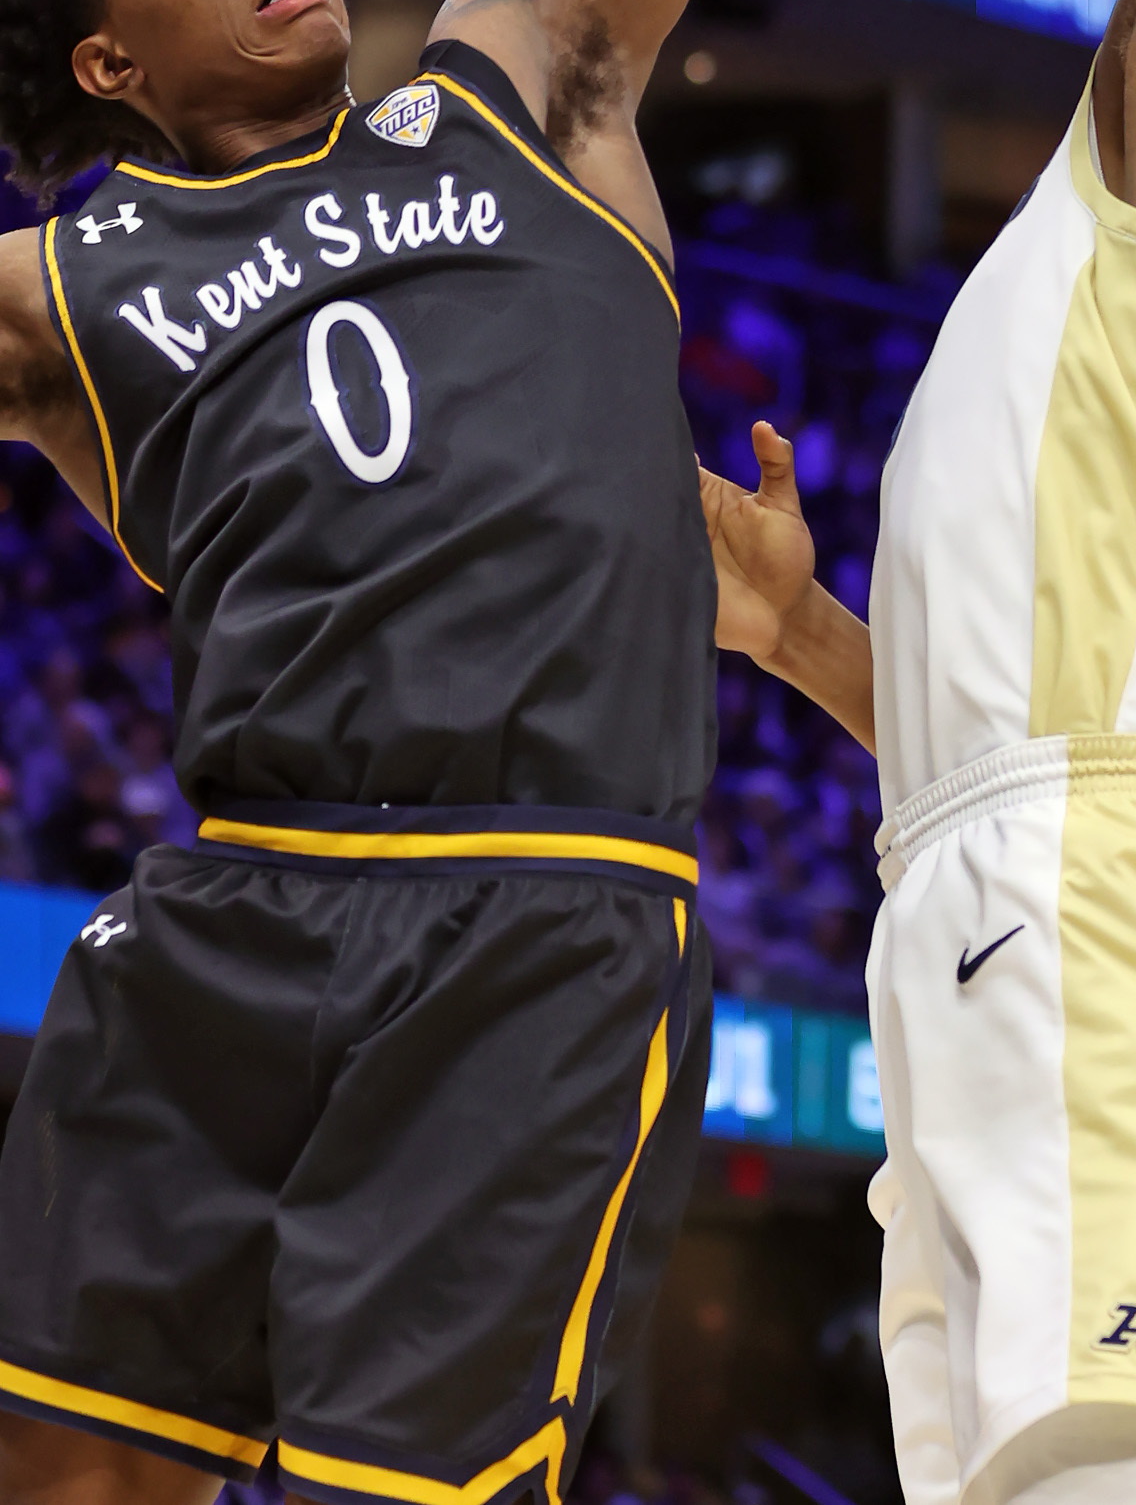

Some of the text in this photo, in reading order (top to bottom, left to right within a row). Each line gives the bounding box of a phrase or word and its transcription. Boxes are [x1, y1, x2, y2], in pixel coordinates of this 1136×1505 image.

[379, 95, 434, 136] MAC
[118, 174, 504, 372] Kent State
[306, 301, 412, 483] 0
